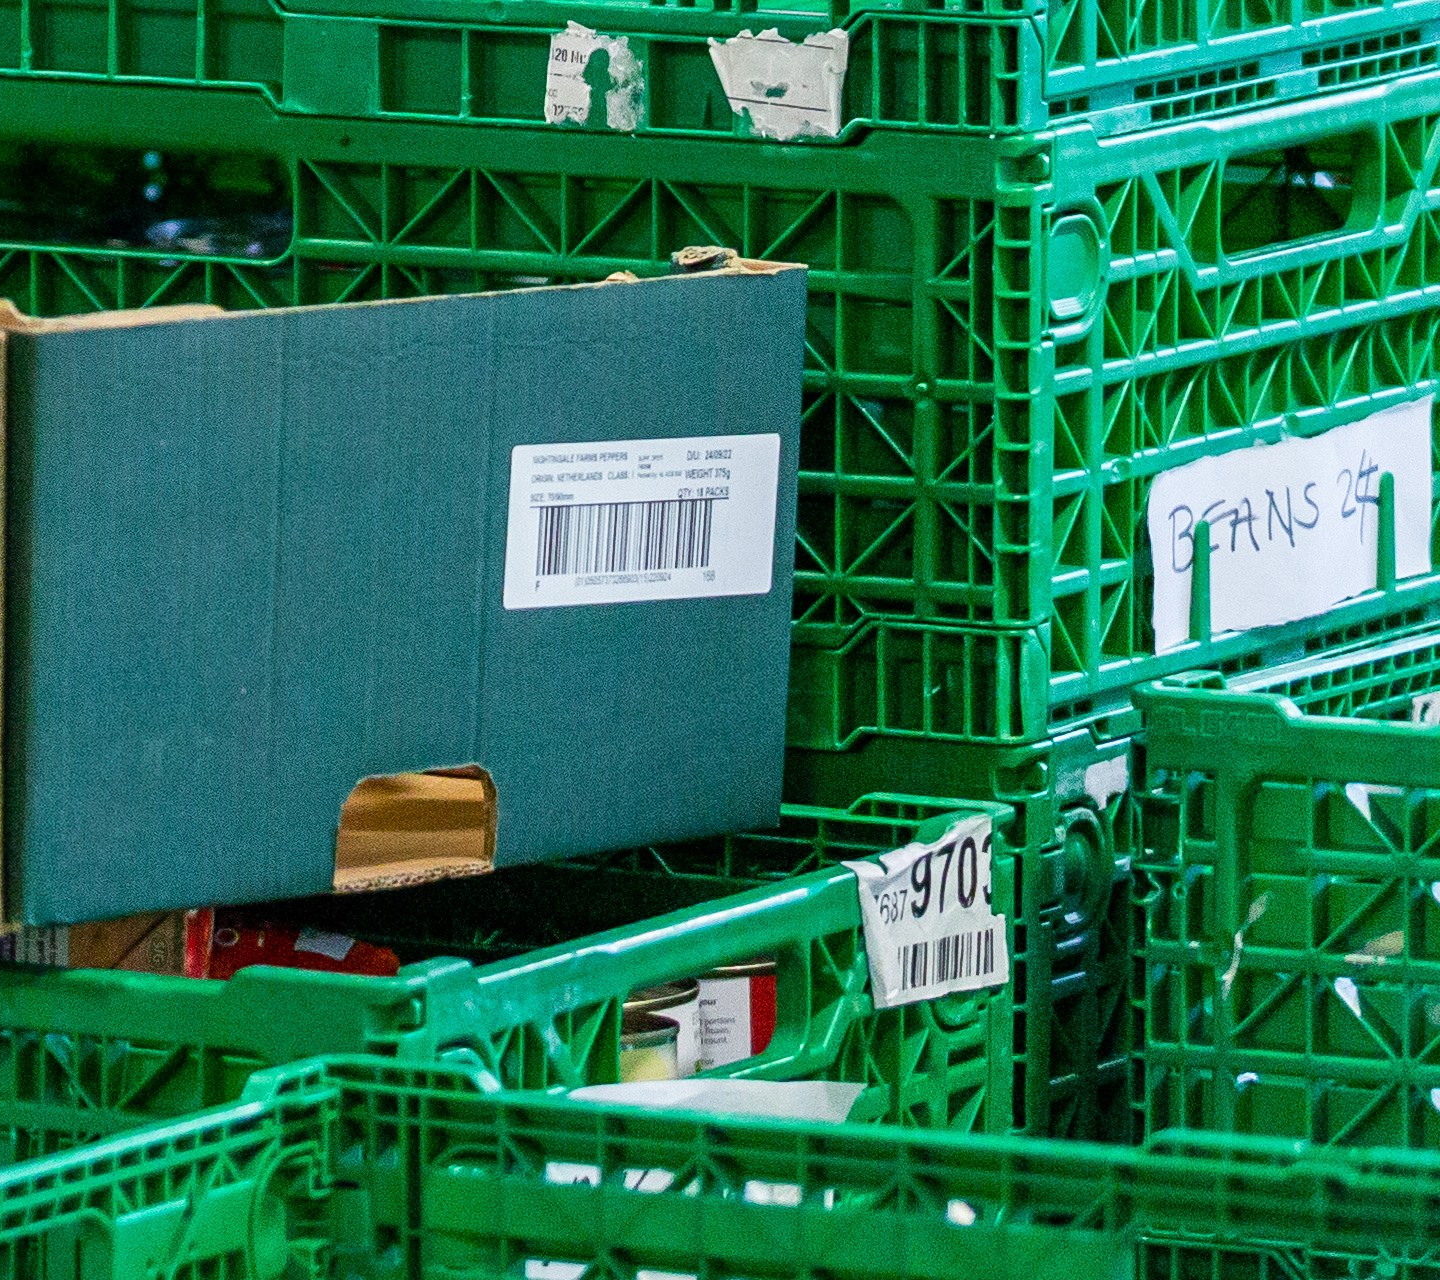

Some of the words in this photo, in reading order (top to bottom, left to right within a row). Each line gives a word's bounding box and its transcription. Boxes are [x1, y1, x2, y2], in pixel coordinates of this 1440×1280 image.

[599, 451, 628, 461] PEPPERS
[557, 472, 603, 481] NETHERLANDS
[684, 468, 714, 479] WEIGHT
[705, 486, 729, 497] PACKS
[1167, 481, 1320, 574] BEANS
[874, 889, 908, 925] 687
